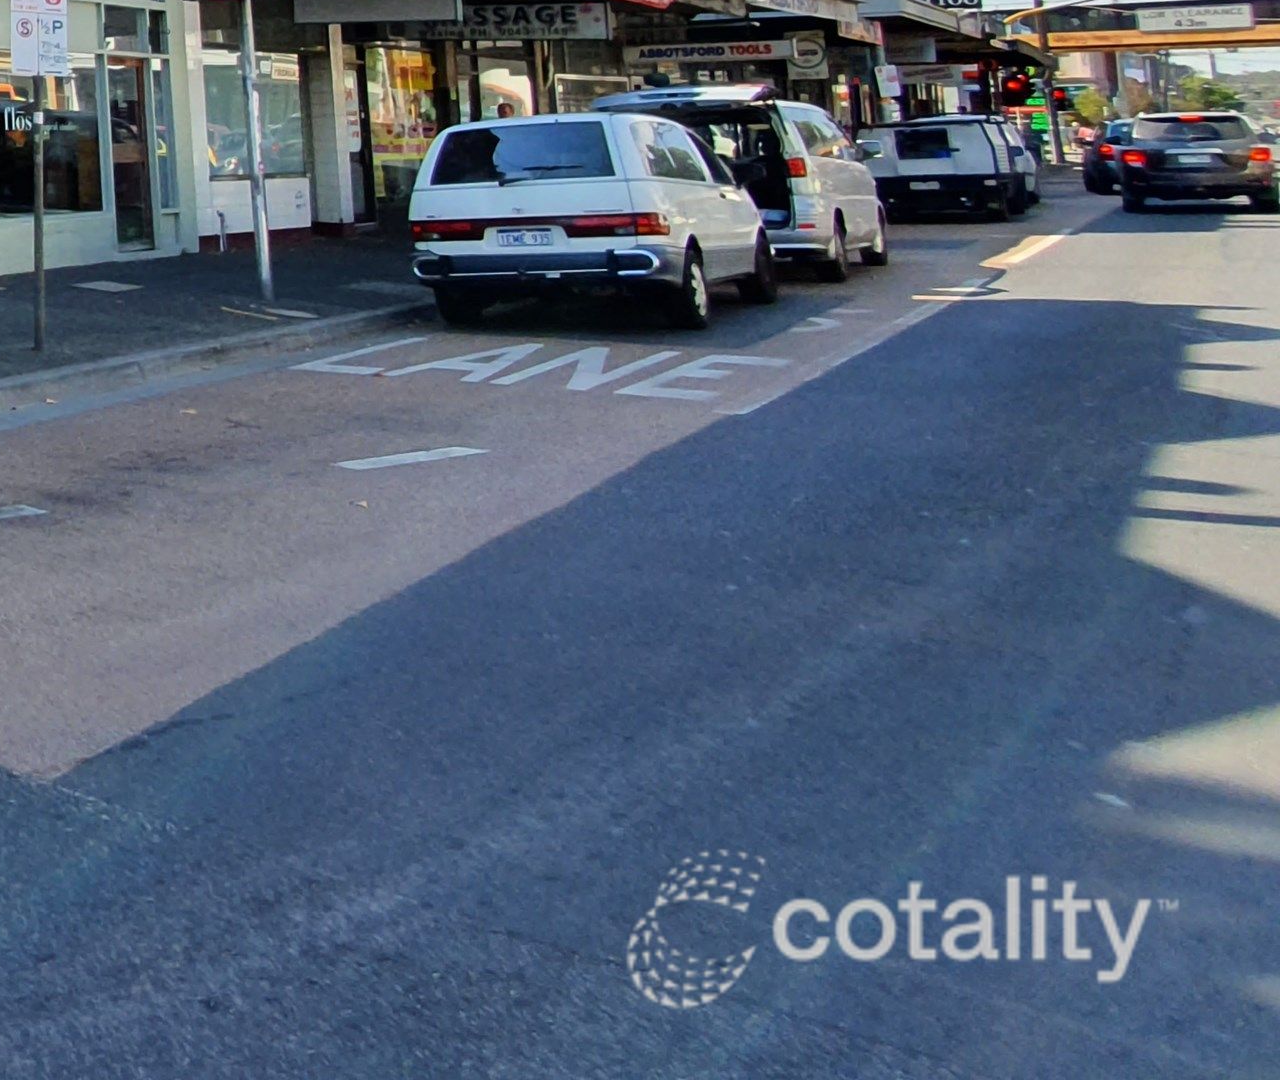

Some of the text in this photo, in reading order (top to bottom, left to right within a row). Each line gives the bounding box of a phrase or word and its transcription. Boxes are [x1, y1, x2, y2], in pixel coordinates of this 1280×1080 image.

[424, 5, 578, 26] SSAGE
[1173, 7, 1244, 18] CLEARANCE
[52, 20, 63, 34] P
[639, 44, 772, 58] ABBOTSFORD TOOLS
[287, 337, 791, 401] LANE
